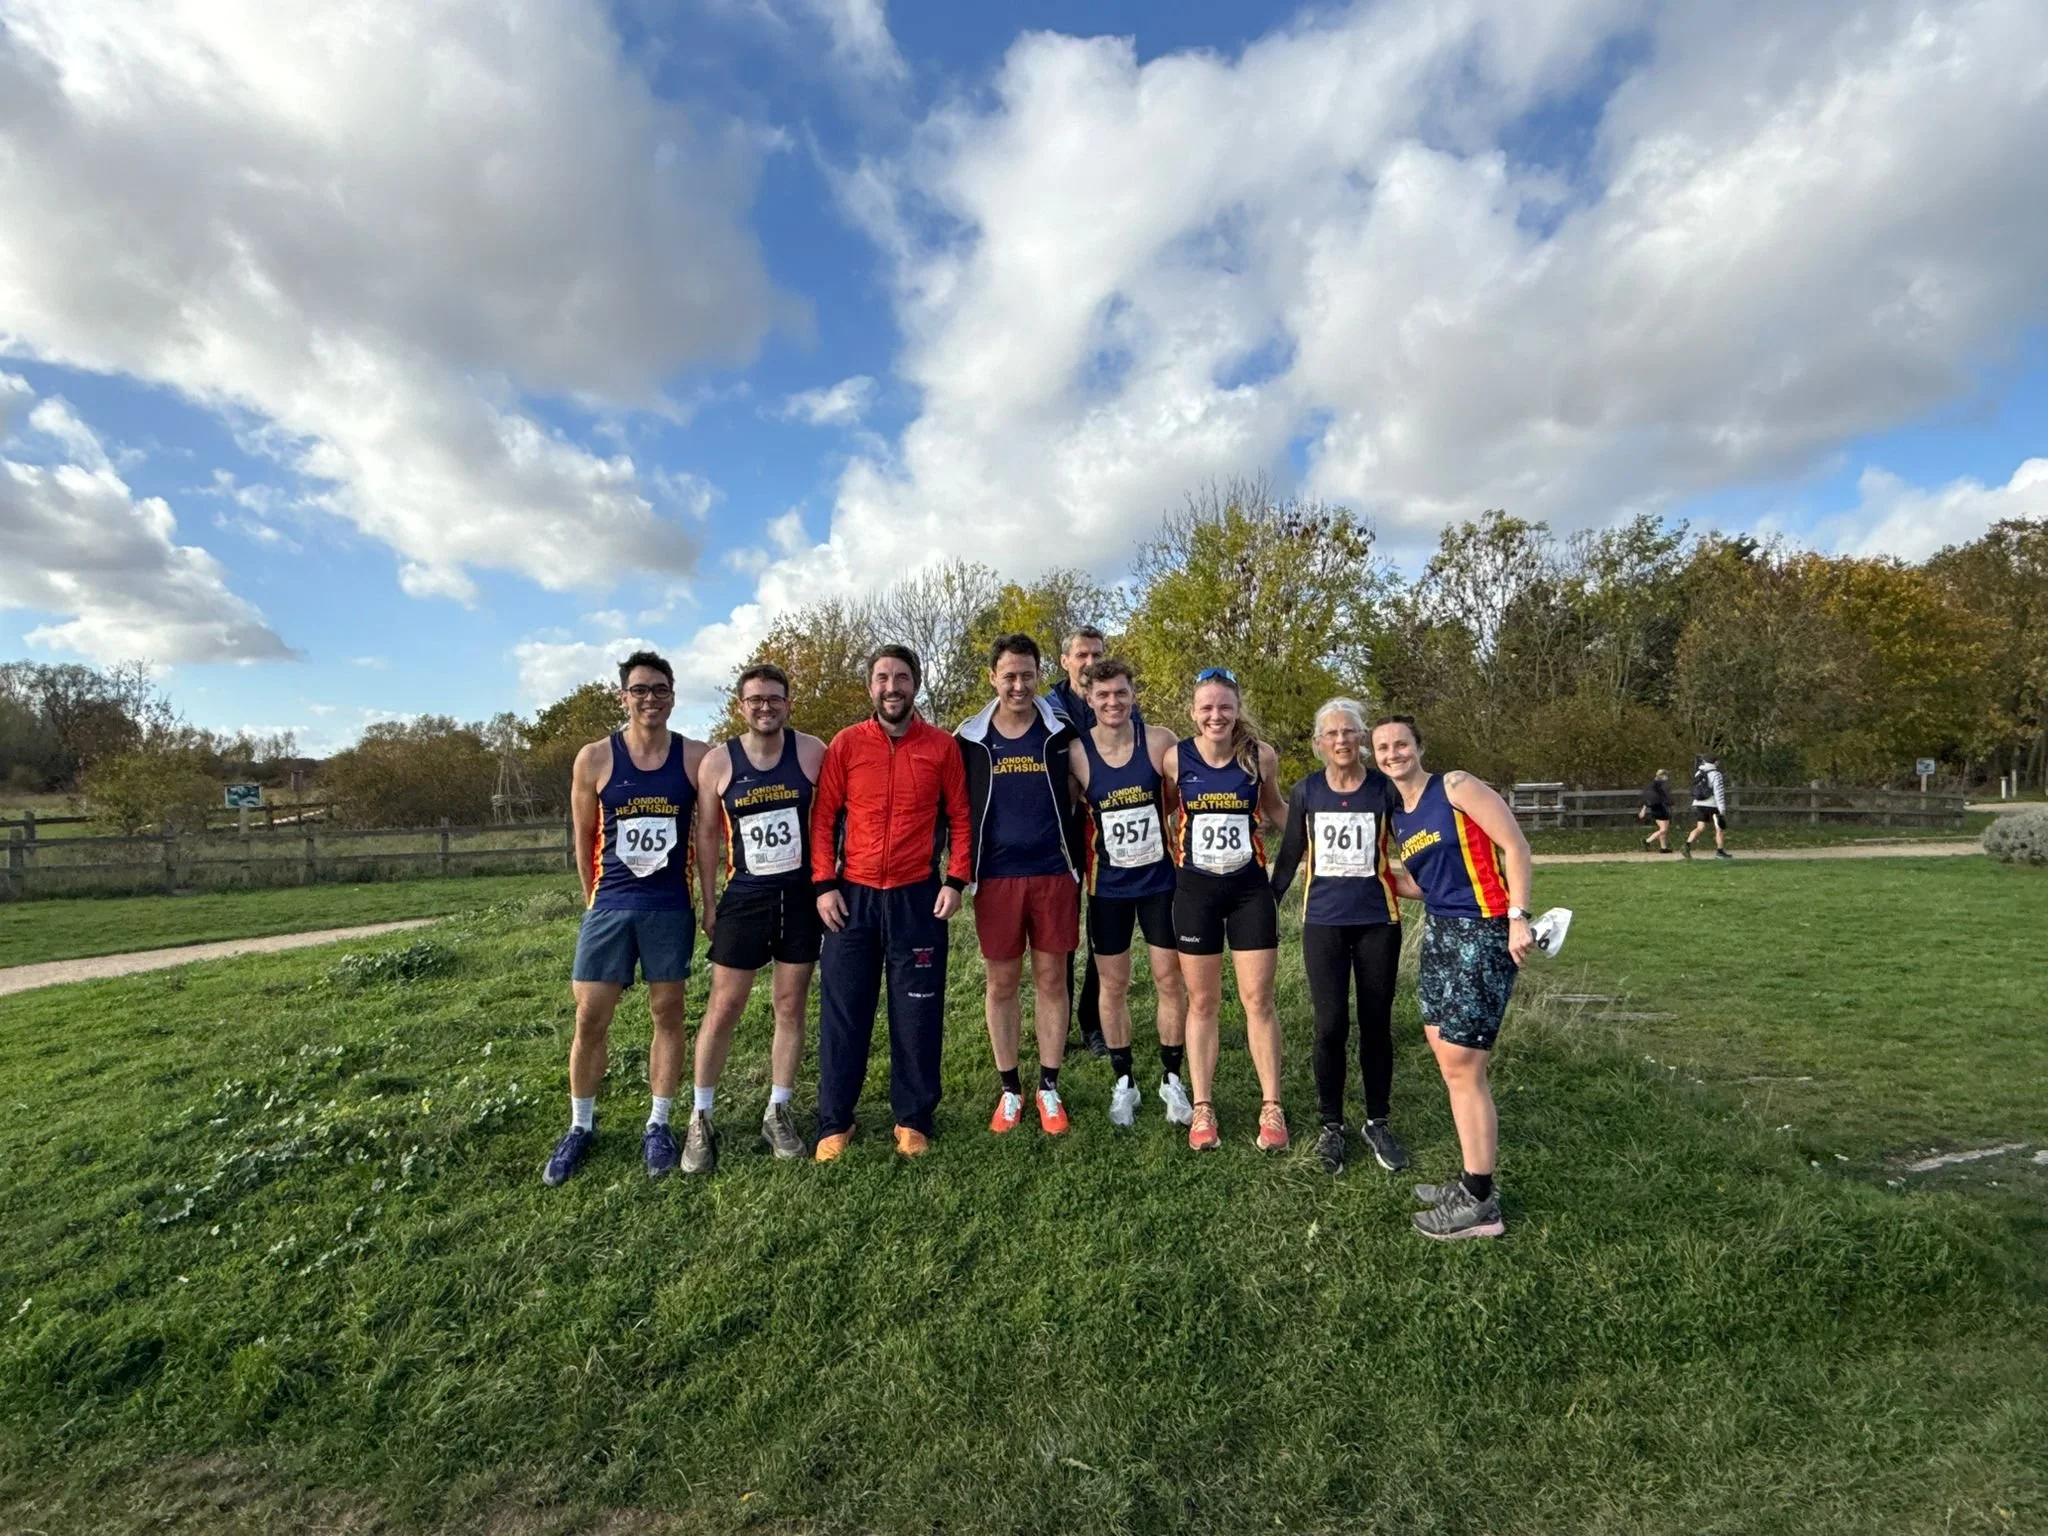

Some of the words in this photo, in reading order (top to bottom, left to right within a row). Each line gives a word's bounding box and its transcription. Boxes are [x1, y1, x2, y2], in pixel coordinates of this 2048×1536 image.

[992, 762, 1046, 775] EATHSIDE
[997, 756, 1034, 765] LONDON
[734, 789, 800, 808] HEATHSIDE
[746, 784, 785, 796] LONDON
[1107, 785, 1142, 799] LONDON
[1197, 792, 1237, 801] LONDON
[628, 796, 668, 806] LONDON
[1099, 791, 1154, 809] HEATHSIDE
[1186, 799, 1250, 810] HEATHSIDE
[614, 804, 680, 816] HEATHSIDE
[625, 828, 667, 852] 965
[750, 821, 792, 850] 963
[1112, 817, 1151, 845] 957
[1202, 826, 1242, 850] 958
[1323, 824, 1362, 850] 961
[1401, 828, 1427, 850] LONDON
[1400, 831, 1442, 862] EATHSIDE
